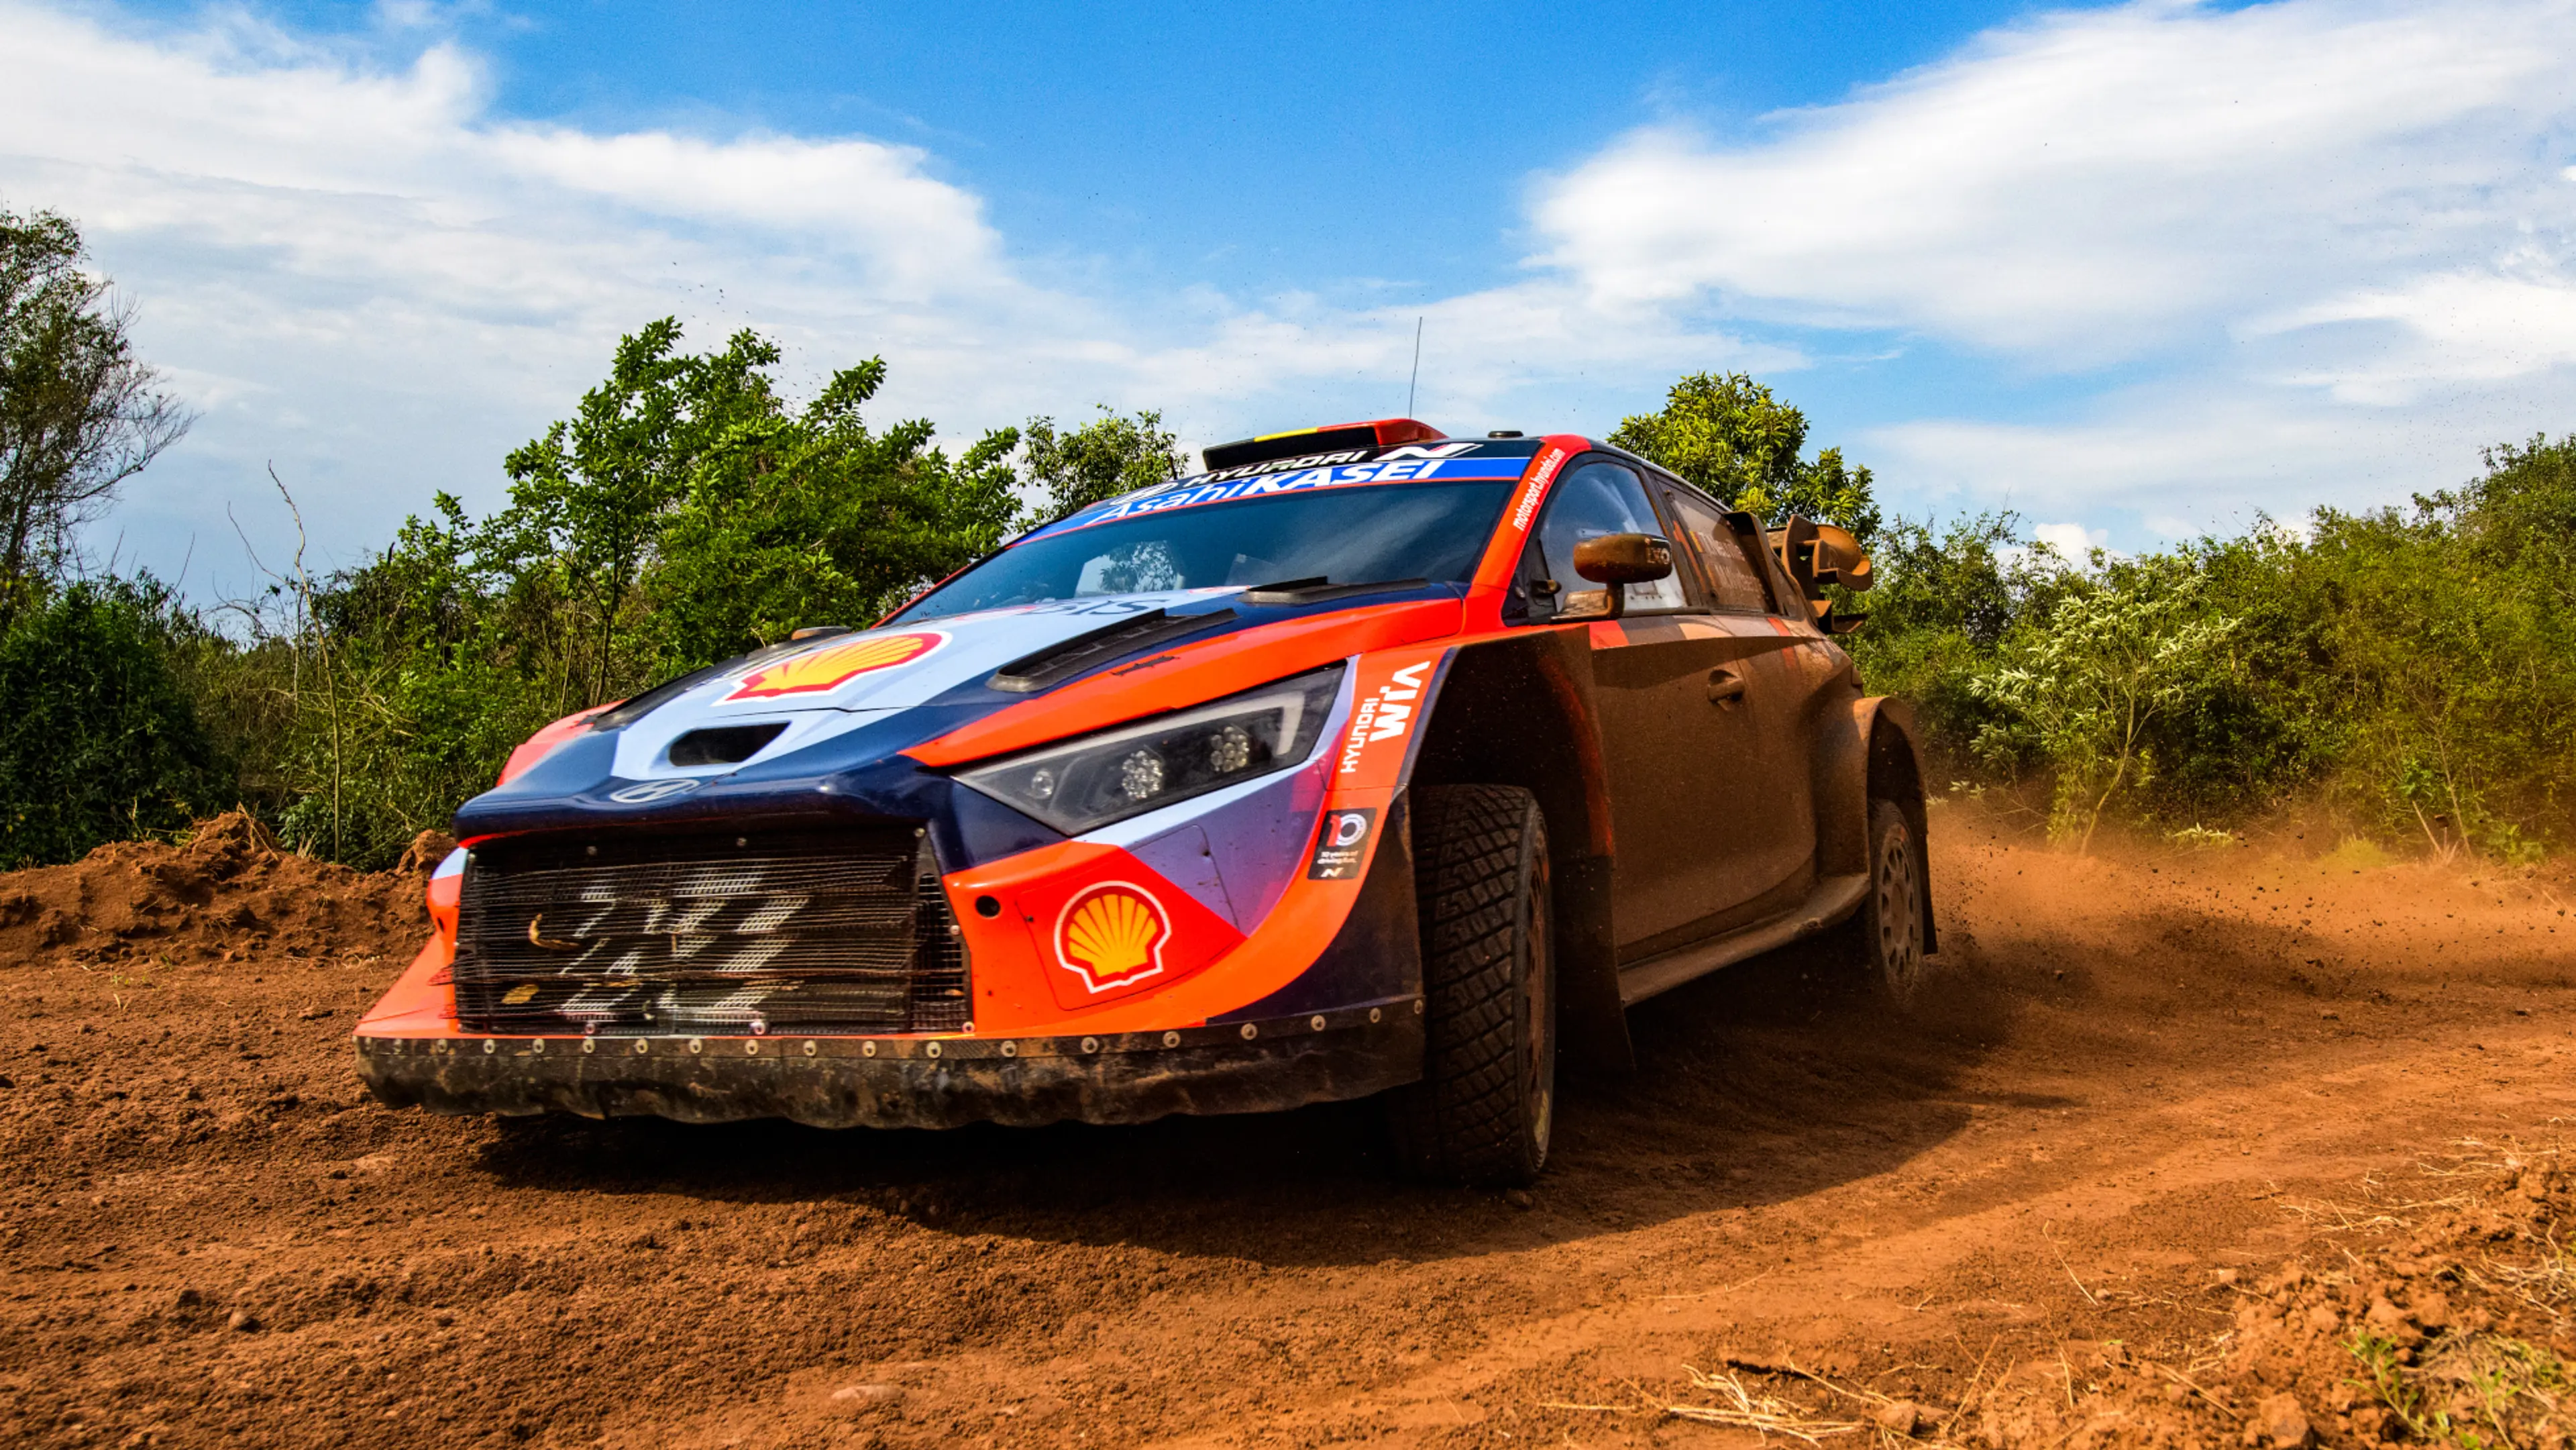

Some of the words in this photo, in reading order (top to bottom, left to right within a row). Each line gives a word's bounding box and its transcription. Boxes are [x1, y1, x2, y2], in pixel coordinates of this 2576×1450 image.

[1183, 451, 1368, 488] HYUNDAI
[1513, 448, 1566, 532] motorsport.hyundai.com
[1340, 697, 1380, 773] HYUNDAI
